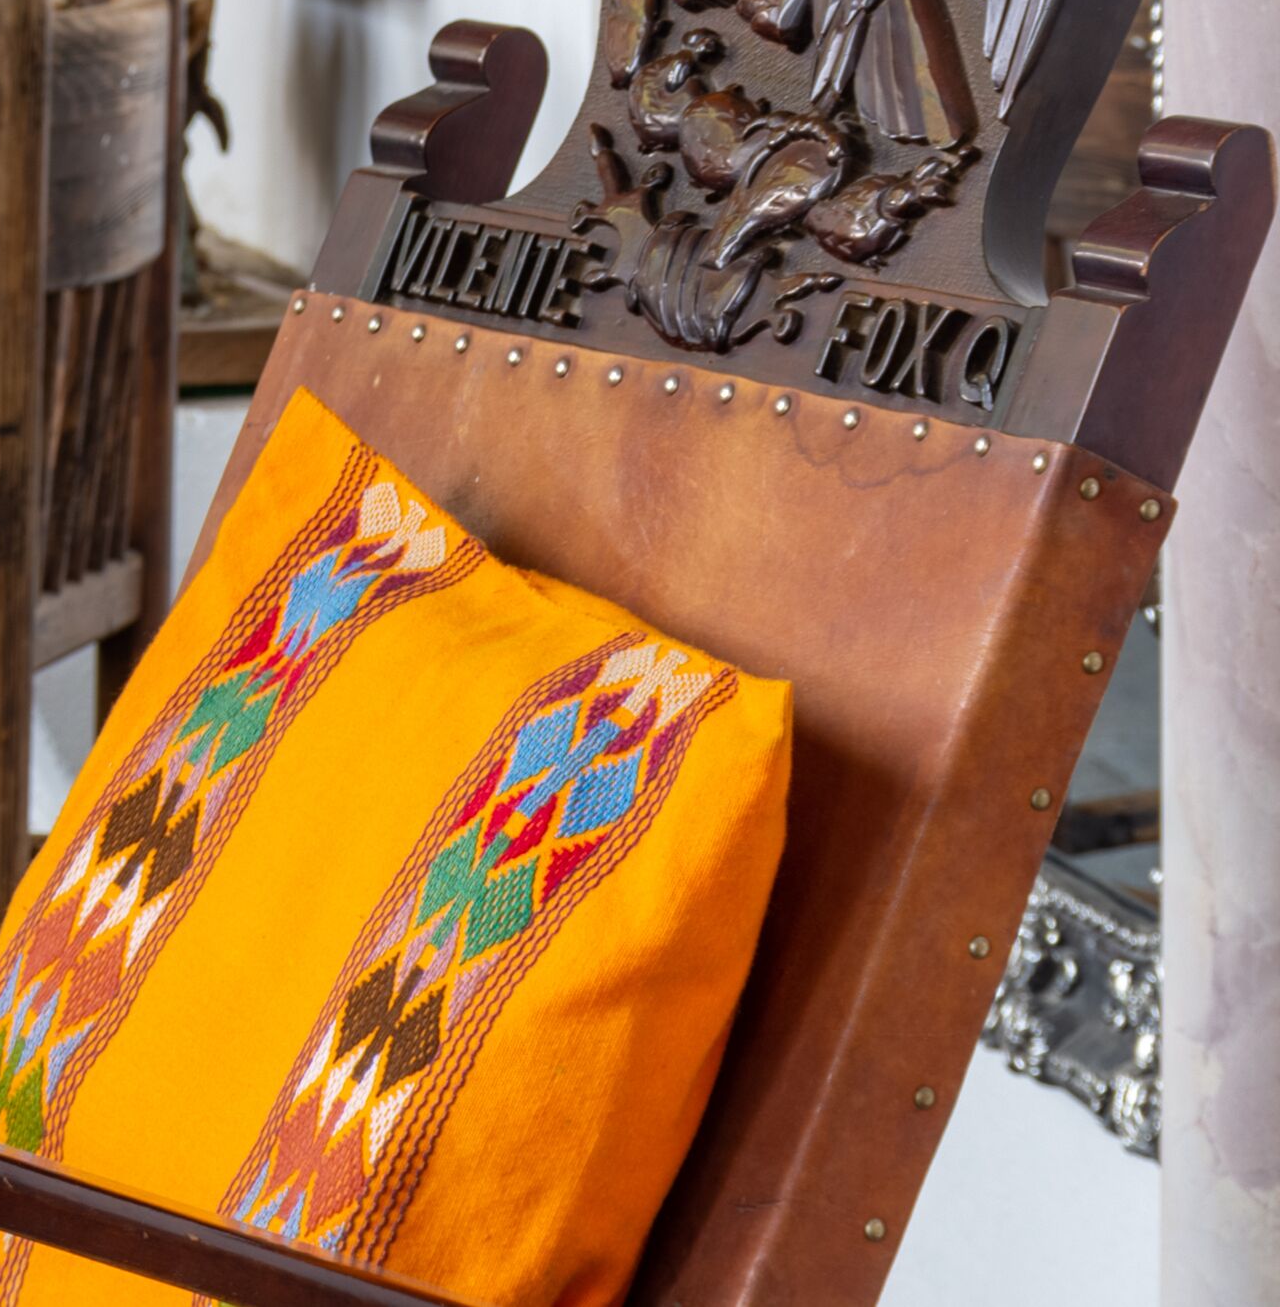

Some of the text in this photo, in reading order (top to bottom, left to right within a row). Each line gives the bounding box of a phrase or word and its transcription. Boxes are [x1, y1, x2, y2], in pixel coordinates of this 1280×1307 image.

[389, 210, 1012, 413] VICENTE FOX Q
